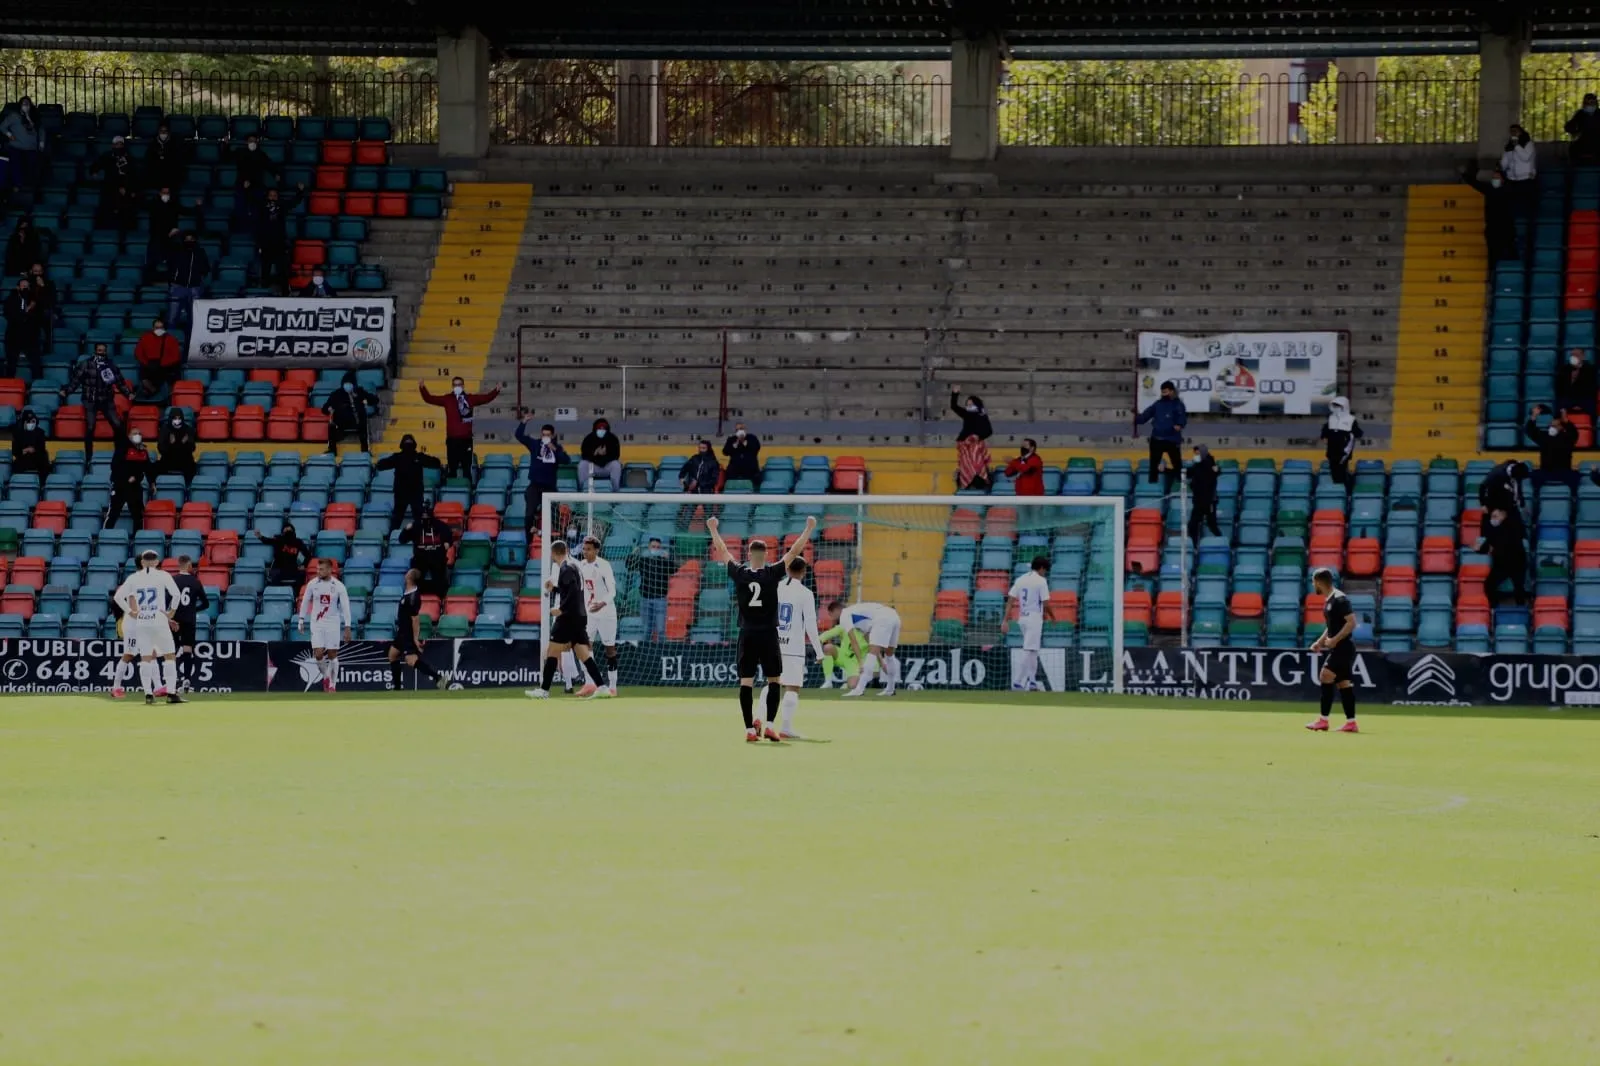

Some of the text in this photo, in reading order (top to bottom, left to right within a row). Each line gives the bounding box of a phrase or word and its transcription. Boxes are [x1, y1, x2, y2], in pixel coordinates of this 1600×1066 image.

[208, 307, 384, 331] SENTIMIENTO
[237, 335, 349, 357] CHARRO
[748, 581, 763, 607] 2
[18, 640, 126, 657] PUBLICID
[36, 660, 90, 680] 648
[97, 660, 142, 681] 40
[660, 655, 684, 681] El
[1490, 661, 1600, 703] grupo
